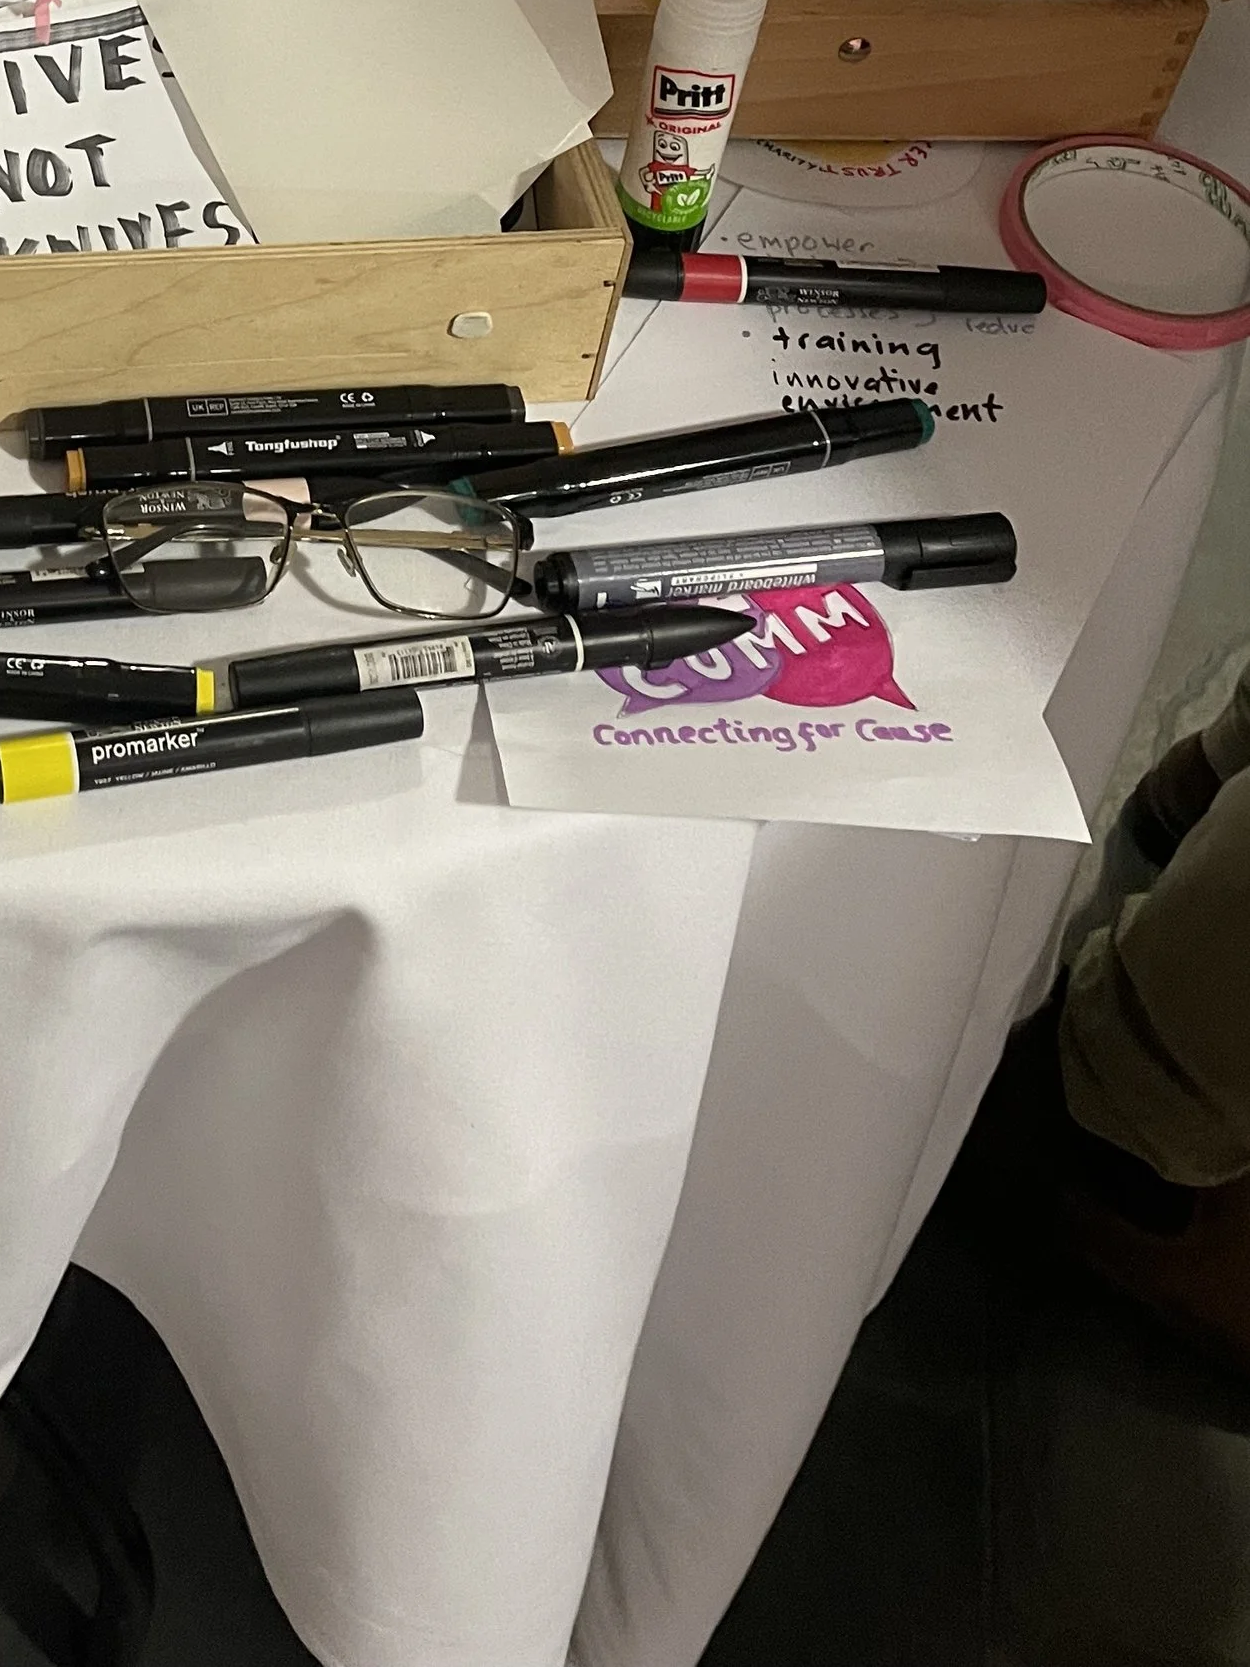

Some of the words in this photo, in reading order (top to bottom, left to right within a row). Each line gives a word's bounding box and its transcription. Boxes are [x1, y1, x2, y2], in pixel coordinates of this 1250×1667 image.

[659, 74, 726, 108] Pritt
[659, 120, 722, 135] ORIGINAL
[756, 138, 818, 171] CHARITY
[658, 172, 684, 182] Pritt
[818, 162, 902, 178] TRUST
[736, 231, 876, 257] empower
[798, 288, 840, 298] WINSOR
[772, 326, 941, 369] training
[771, 358, 939, 396] innovative
[192, 403, 205, 412] UK
[208, 402, 225, 411] REP
[244, 438, 338, 453] Tongfushop
[138, 490, 186, 501] NEWTON
[138, 501, 186, 514] WINSOR
[665, 582, 723, 596] marker
[593, 717, 798, 752] Connecting
[797, 722, 846, 752] for
[854, 718, 954, 744] Cause
[115, 771, 145, 782] YELLOW
